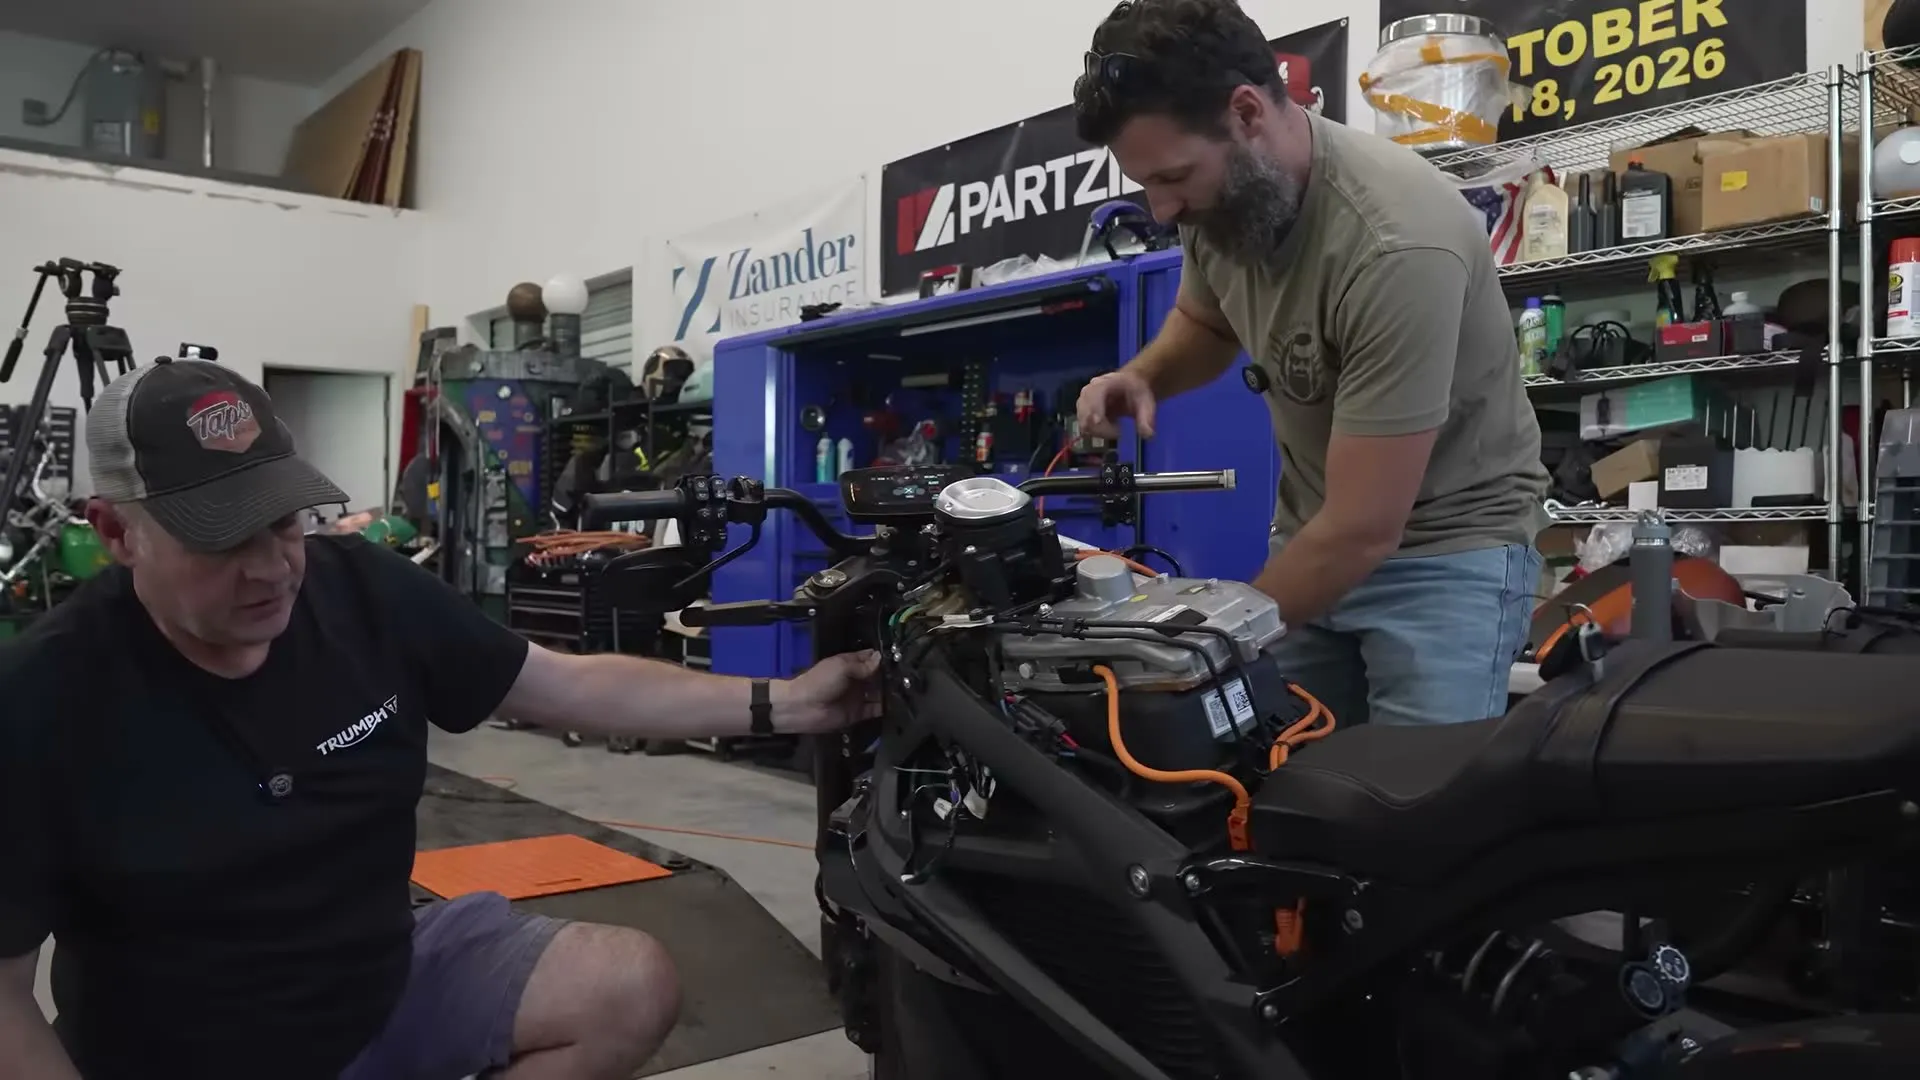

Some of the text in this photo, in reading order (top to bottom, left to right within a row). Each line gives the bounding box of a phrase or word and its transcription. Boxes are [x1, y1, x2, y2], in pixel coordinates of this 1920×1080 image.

[1507, 0, 1728, 77] TOBER
[1593, 38, 1726, 105] 2026
[728, 227, 855, 300] Zander
[730, 280, 856, 326] INSURANCE
[317, 707, 388, 756] TRIUMPH
